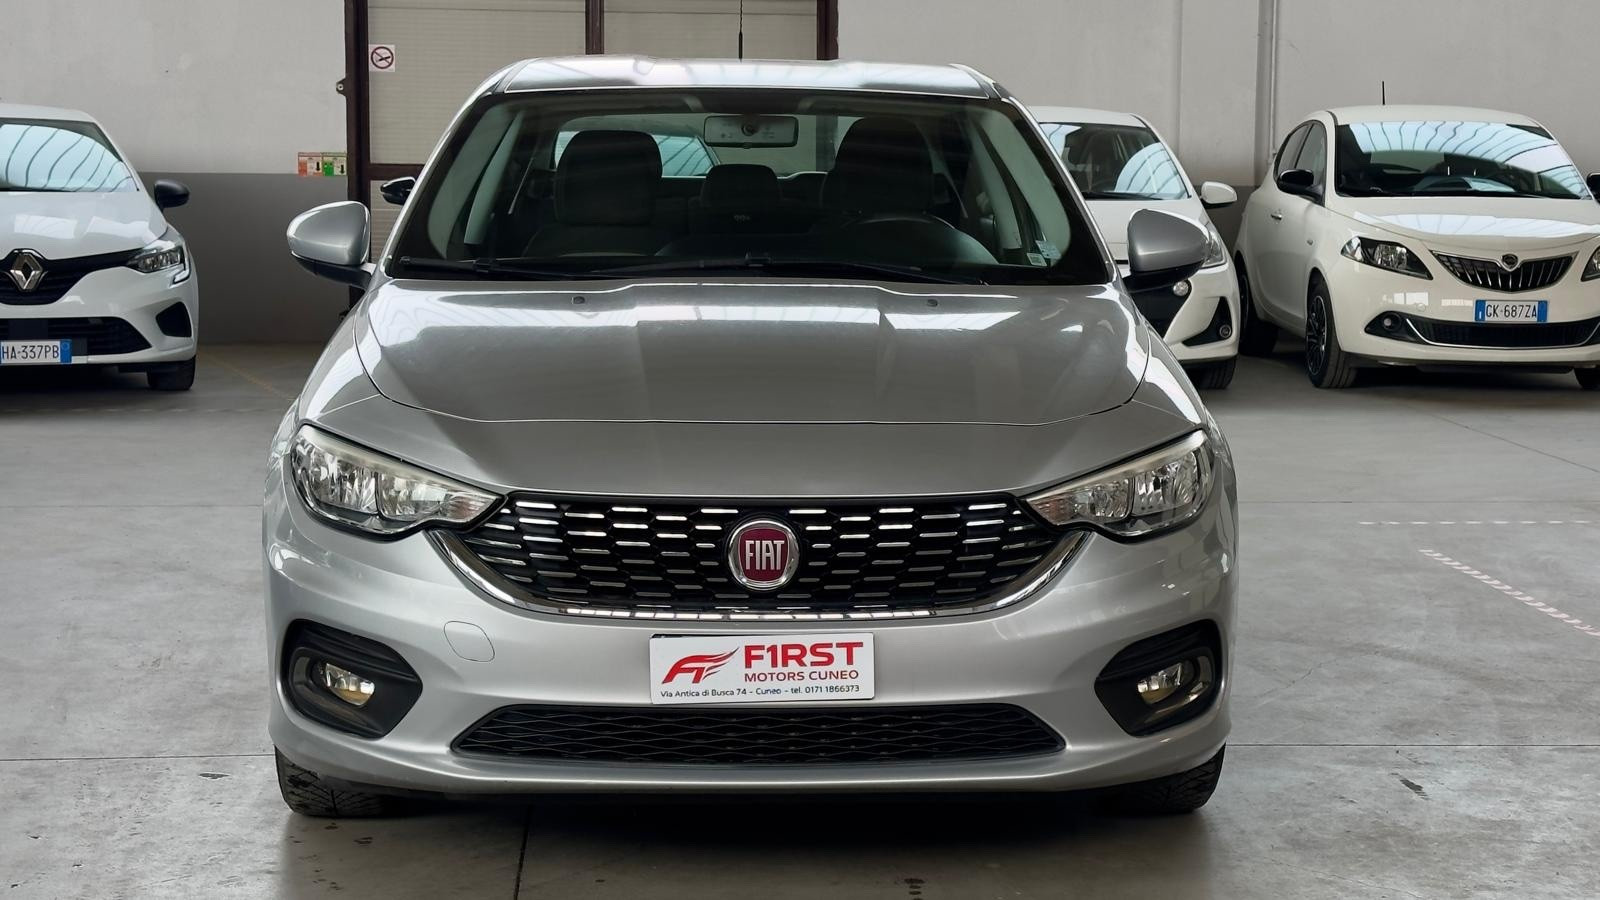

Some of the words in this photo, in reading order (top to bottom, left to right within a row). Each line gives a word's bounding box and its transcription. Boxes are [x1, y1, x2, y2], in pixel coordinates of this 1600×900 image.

[745, 540, 785, 570] FIAT
[744, 642, 864, 668] F1RST
[744, 671, 805, 683] MOTORS
[808, 670, 859, 681] CUNEO
[660, 690, 673, 698] Via
[674, 689, 700, 697] Antica
[701, 688, 710, 697] di
[711, 688, 734, 696] Busca
[736, 687, 747, 696] 74
[755, 687, 782, 695] Cuneo
[790, 686, 803, 694] tel.
[805, 685, 823, 694] 0171
[825, 684, 860, 693] 1866373
